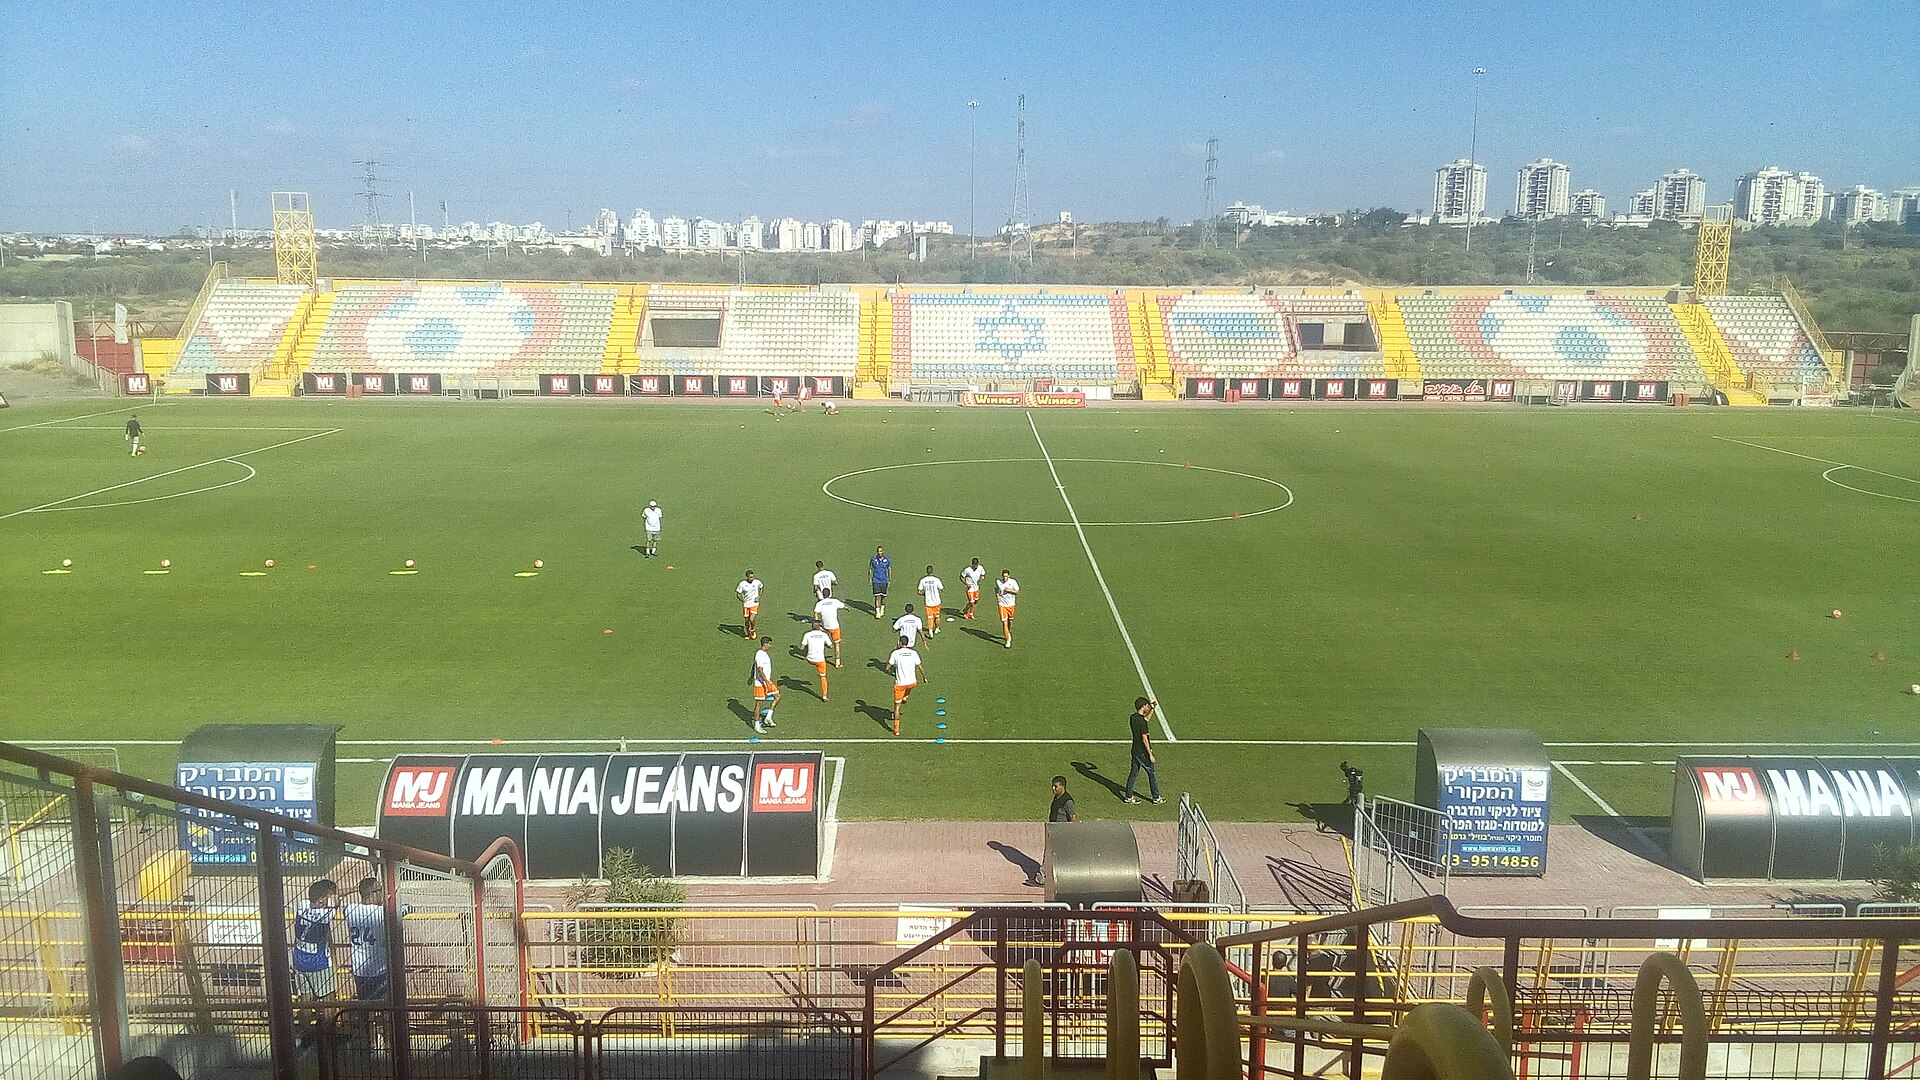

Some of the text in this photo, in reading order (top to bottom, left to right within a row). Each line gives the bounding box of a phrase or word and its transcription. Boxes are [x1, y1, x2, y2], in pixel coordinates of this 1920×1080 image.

[128, 377, 146, 390] MJ
[219, 377, 237, 390] MJ
[317, 377, 333, 389] MJ
[366, 377, 382, 389] MJ
[412, 377, 428, 389] MJ
[553, 378, 568, 390] MJ
[597, 378, 612, 390] MJ
[643, 378, 658, 390] MJ
[686, 379, 701, 391] MJ
[731, 379, 746, 391] MJ
[816, 379, 832, 391] MJ
[1198, 382, 1213, 393] MJ
[1241, 382, 1257, 393] MJ
[1284, 382, 1299, 393] MJ
[1328, 383, 1342, 394] MJ
[1370, 383, 1386, 394] MJ
[1494, 383, 1513, 396] MJ
[1594, 384, 1610, 395] MJ
[1639, 384, 1655, 395] MJ
[179, 767, 282, 787] המבריק
[759, 768, 809, 798] MJ
[1443, 768, 1518, 786] המבריק
[392, 771, 448, 802] MJ
[461, 765, 744, 816] MANIA JEANS
[1701, 771, 1757, 801] MJ
[1447, 785, 1514, 803] המקורי
[1766, 769, 1912, 817] MANIA
[286, 807, 312, 819] ציוד
[1446, 804, 1542, 819] ציוד לניקוי והדברה
[1441, 854, 1540, 868] 03-9514856
